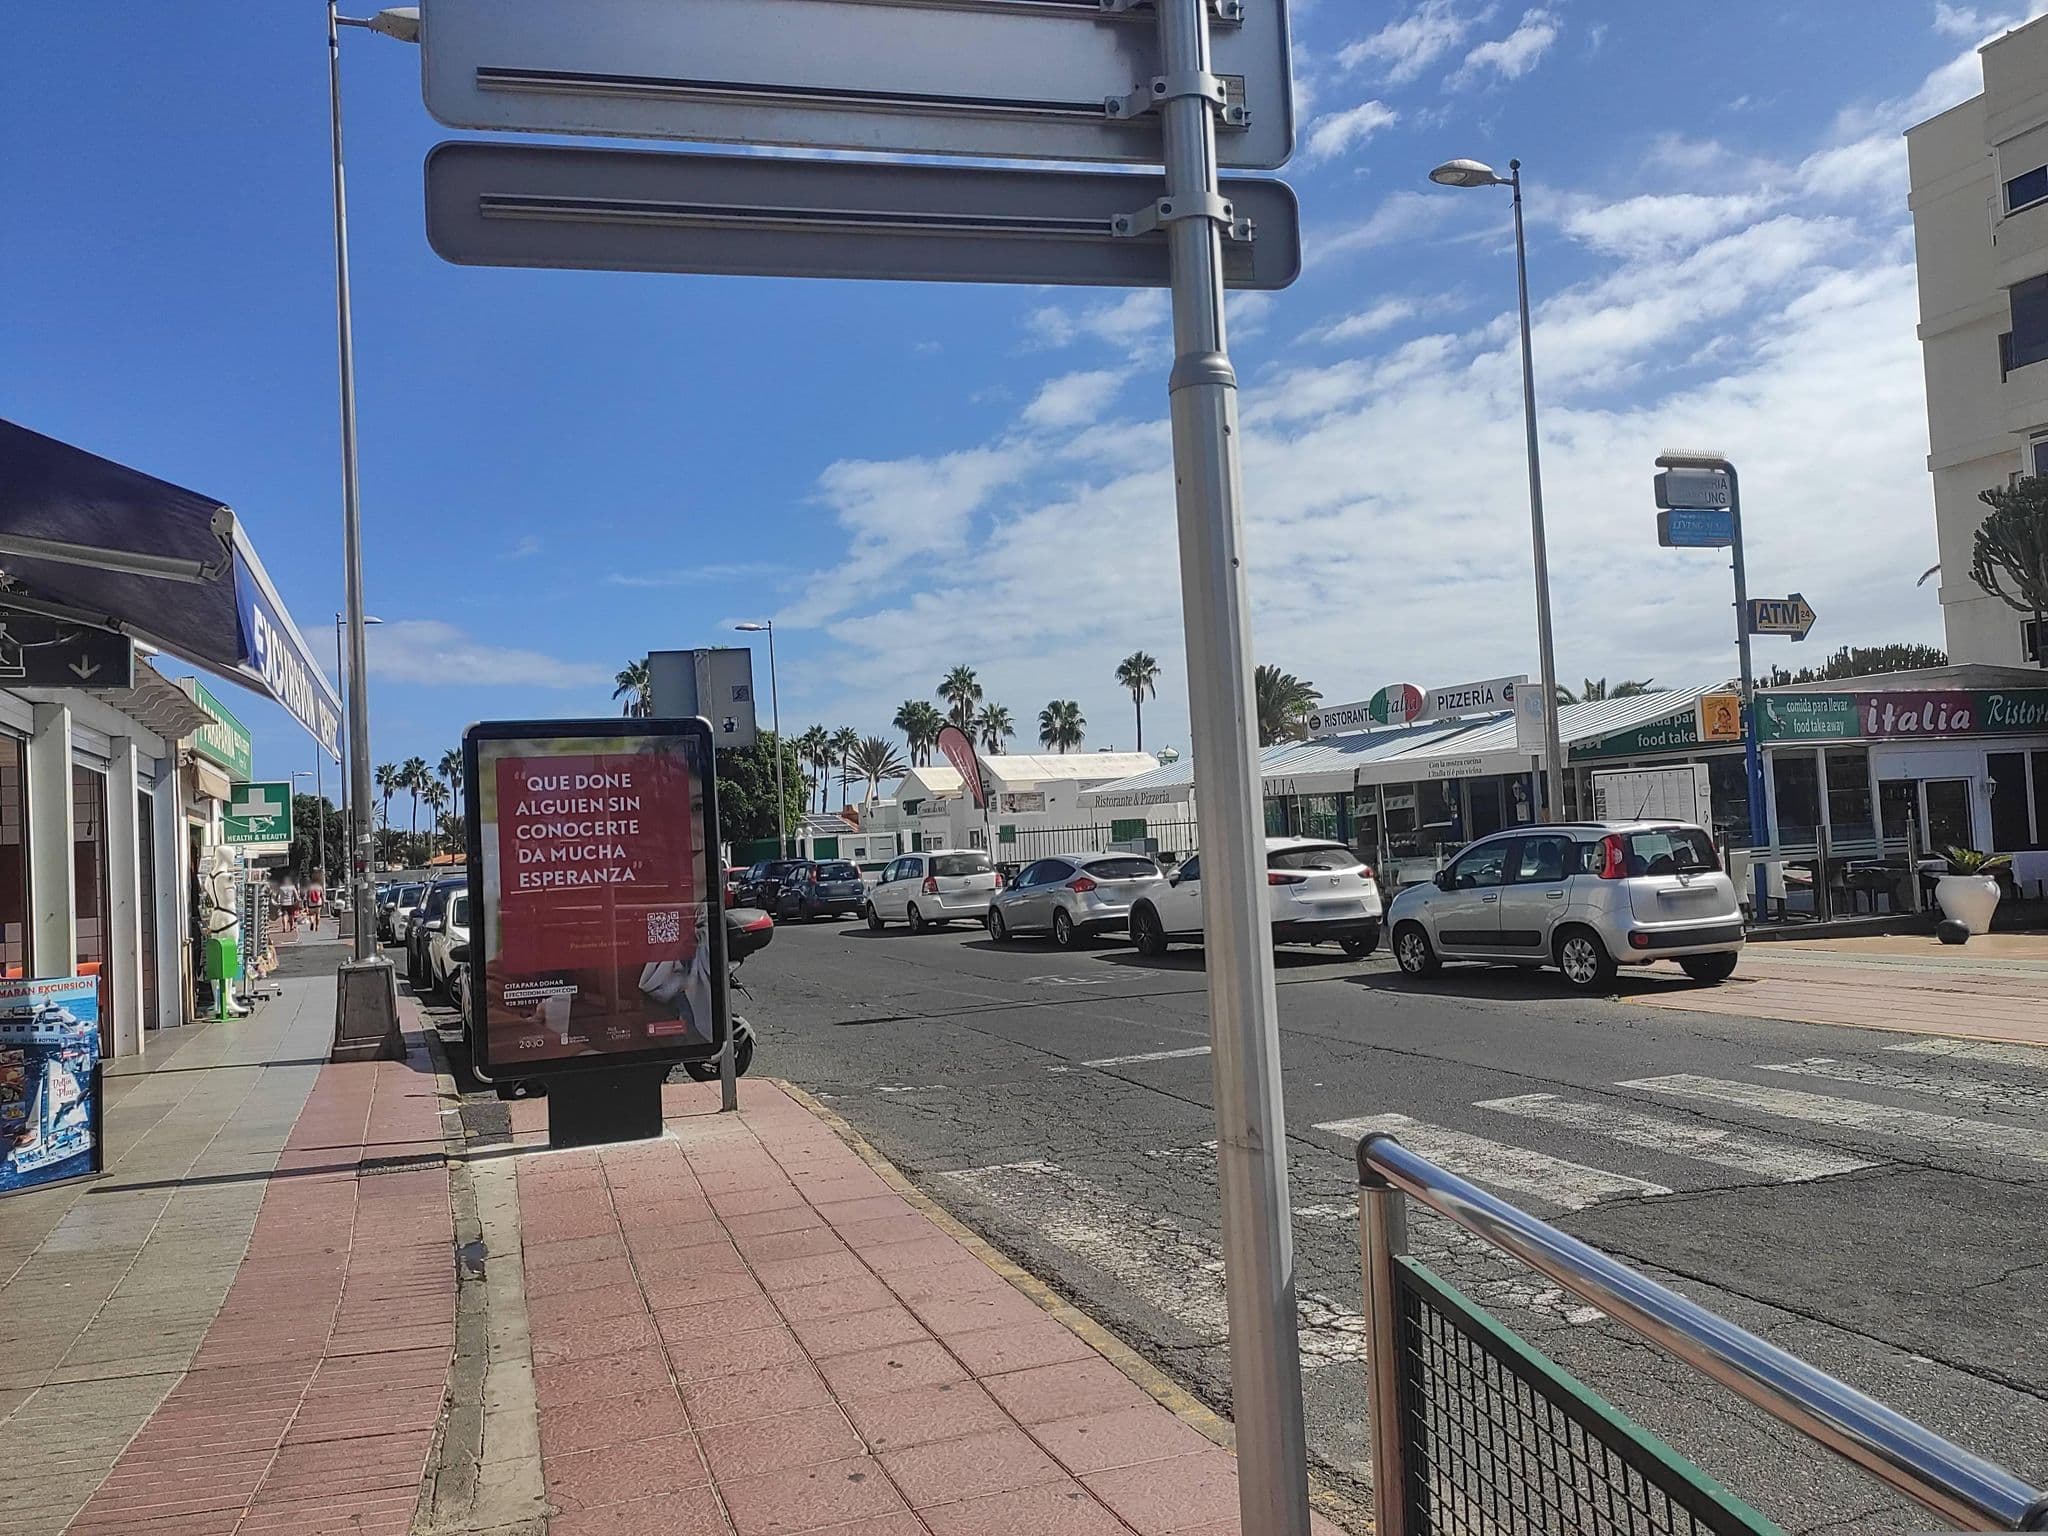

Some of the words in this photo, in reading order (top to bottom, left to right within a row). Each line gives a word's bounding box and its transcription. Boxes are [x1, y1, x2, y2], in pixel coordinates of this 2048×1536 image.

[1758, 602, 1801, 624] ATM
[1800, 610, 1810, 618] 24
[1378, 691, 1418, 716] Italia
[1437, 685, 1495, 711] PIZZERÍA
[1786, 697, 1812, 713] comida
[1812, 701, 1828, 716] para
[1828, 697, 1848, 712] llevar
[1674, 711, 1696, 728] par
[1866, 698, 1971, 734] italia
[1793, 717, 1810, 734] food
[1811, 717, 1826, 732] take
[1826, 721, 1844, 735] away
[1637, 732, 1666, 747] food
[1669, 729, 1697, 744] take
[575, 773, 632, 790] DONE
[1263, 778, 1297, 796] ALIA
[515, 797, 604, 816] ALGUIEN
[608, 796, 640, 812] SIN
[1095, 794, 1133, 808] Ristorante
[1133, 792, 1140, 806] &
[227, 834, 253, 842] HEALTH
[261, 832, 288, 841] BEAUTY
[516, 819, 640, 840] CONOCERTE
[518, 848, 546, 864] DA
[550, 844, 626, 862] MUCHA
[0, 987, 35, 998] MARAN
[38, 980, 93, 994] EXCURSION
[521, 981, 539, 989] PARA
[539, 979, 564, 987] DONAR
